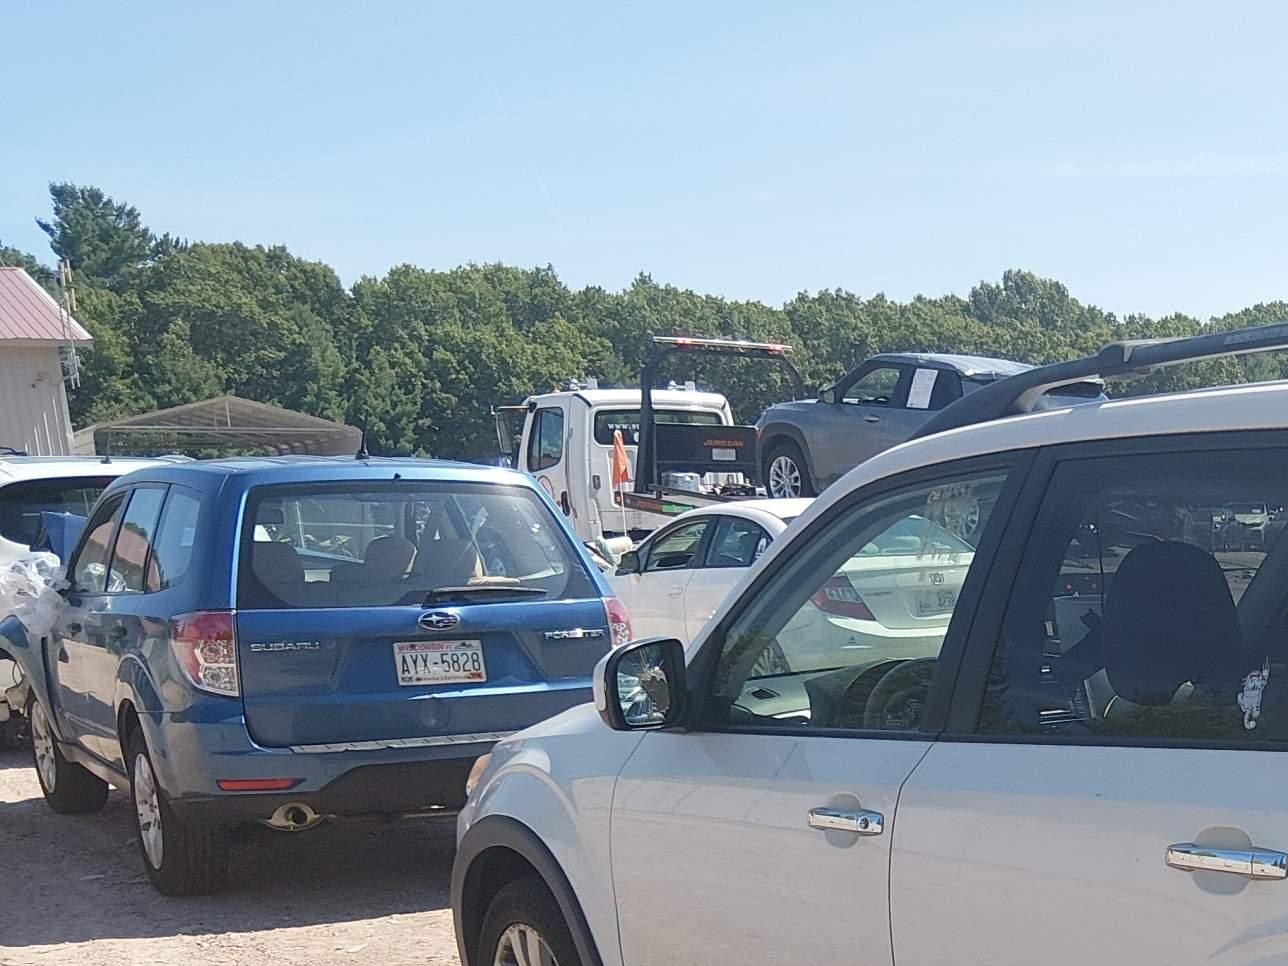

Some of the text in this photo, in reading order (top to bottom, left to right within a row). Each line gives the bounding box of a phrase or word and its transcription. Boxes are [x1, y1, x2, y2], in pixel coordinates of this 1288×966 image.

[250, 642, 320, 651] SUBARU
[399, 643, 446, 652] WISCONSIN
[401, 652, 481, 675] AYX-5828
